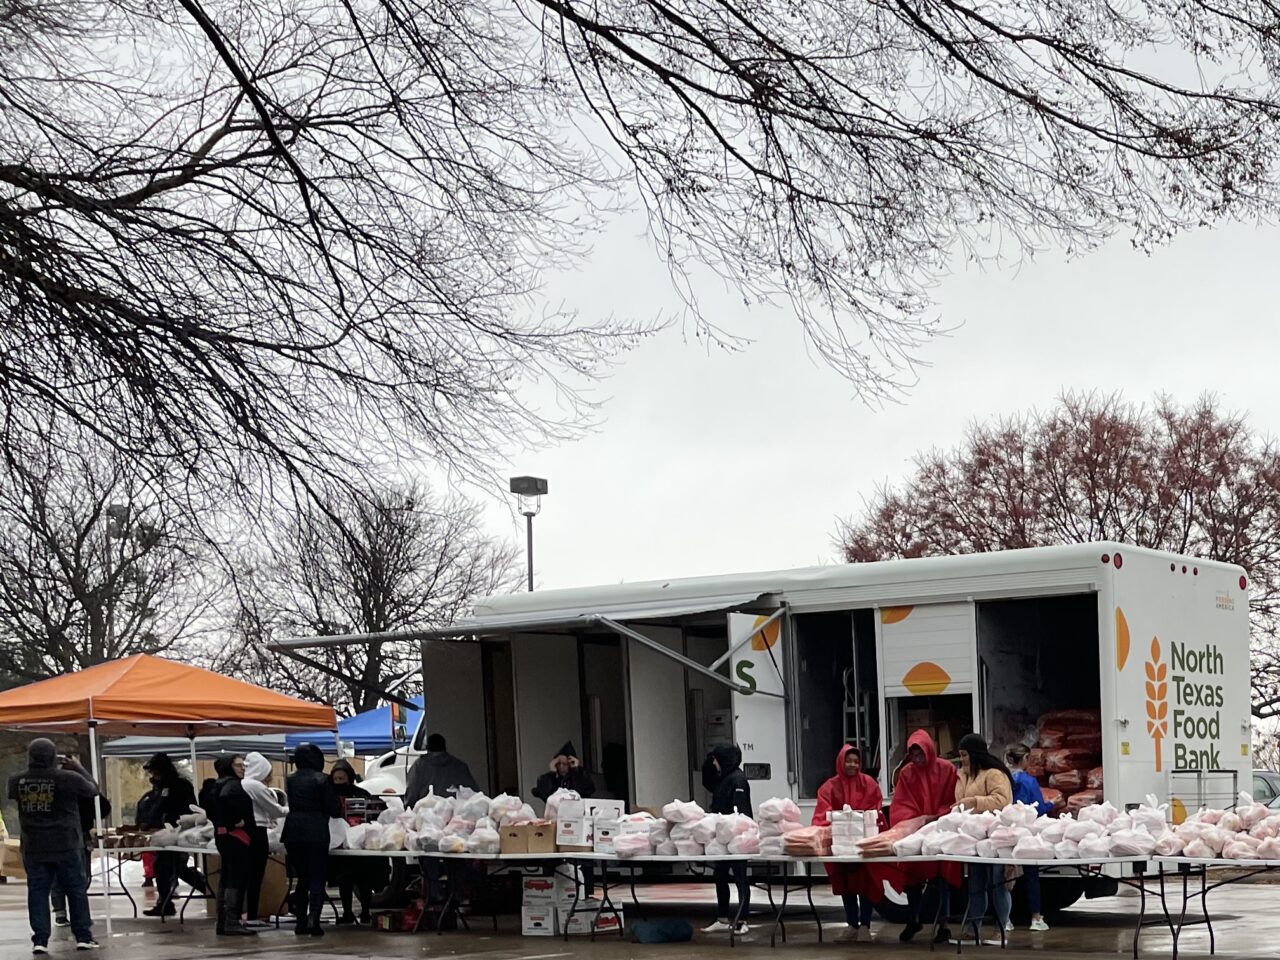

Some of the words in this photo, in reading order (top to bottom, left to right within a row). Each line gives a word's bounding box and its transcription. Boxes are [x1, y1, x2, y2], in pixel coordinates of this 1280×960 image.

[1171, 641, 1224, 675] North
[1172, 675, 1224, 707] Texas
[1173, 709, 1220, 740] Food
[1174, 742, 1220, 770] Bank
[18, 783, 55, 793] HOPE
